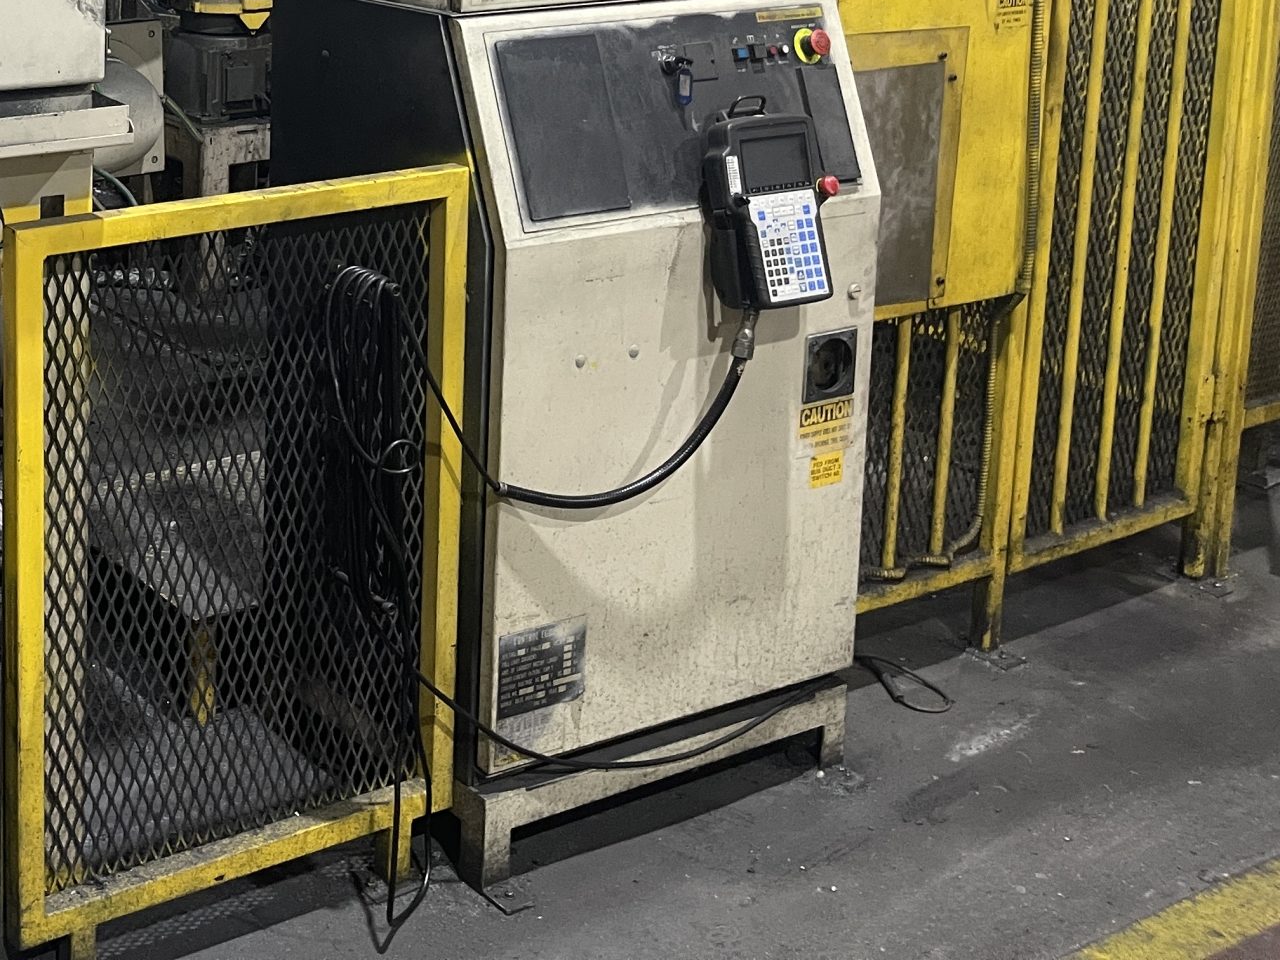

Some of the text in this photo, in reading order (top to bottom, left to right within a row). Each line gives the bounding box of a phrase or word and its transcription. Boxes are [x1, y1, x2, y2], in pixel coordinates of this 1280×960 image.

[802, 401, 852, 426] CAUTION
[822, 464, 836, 472] DUCT
[812, 473, 832, 481] SWITCH
